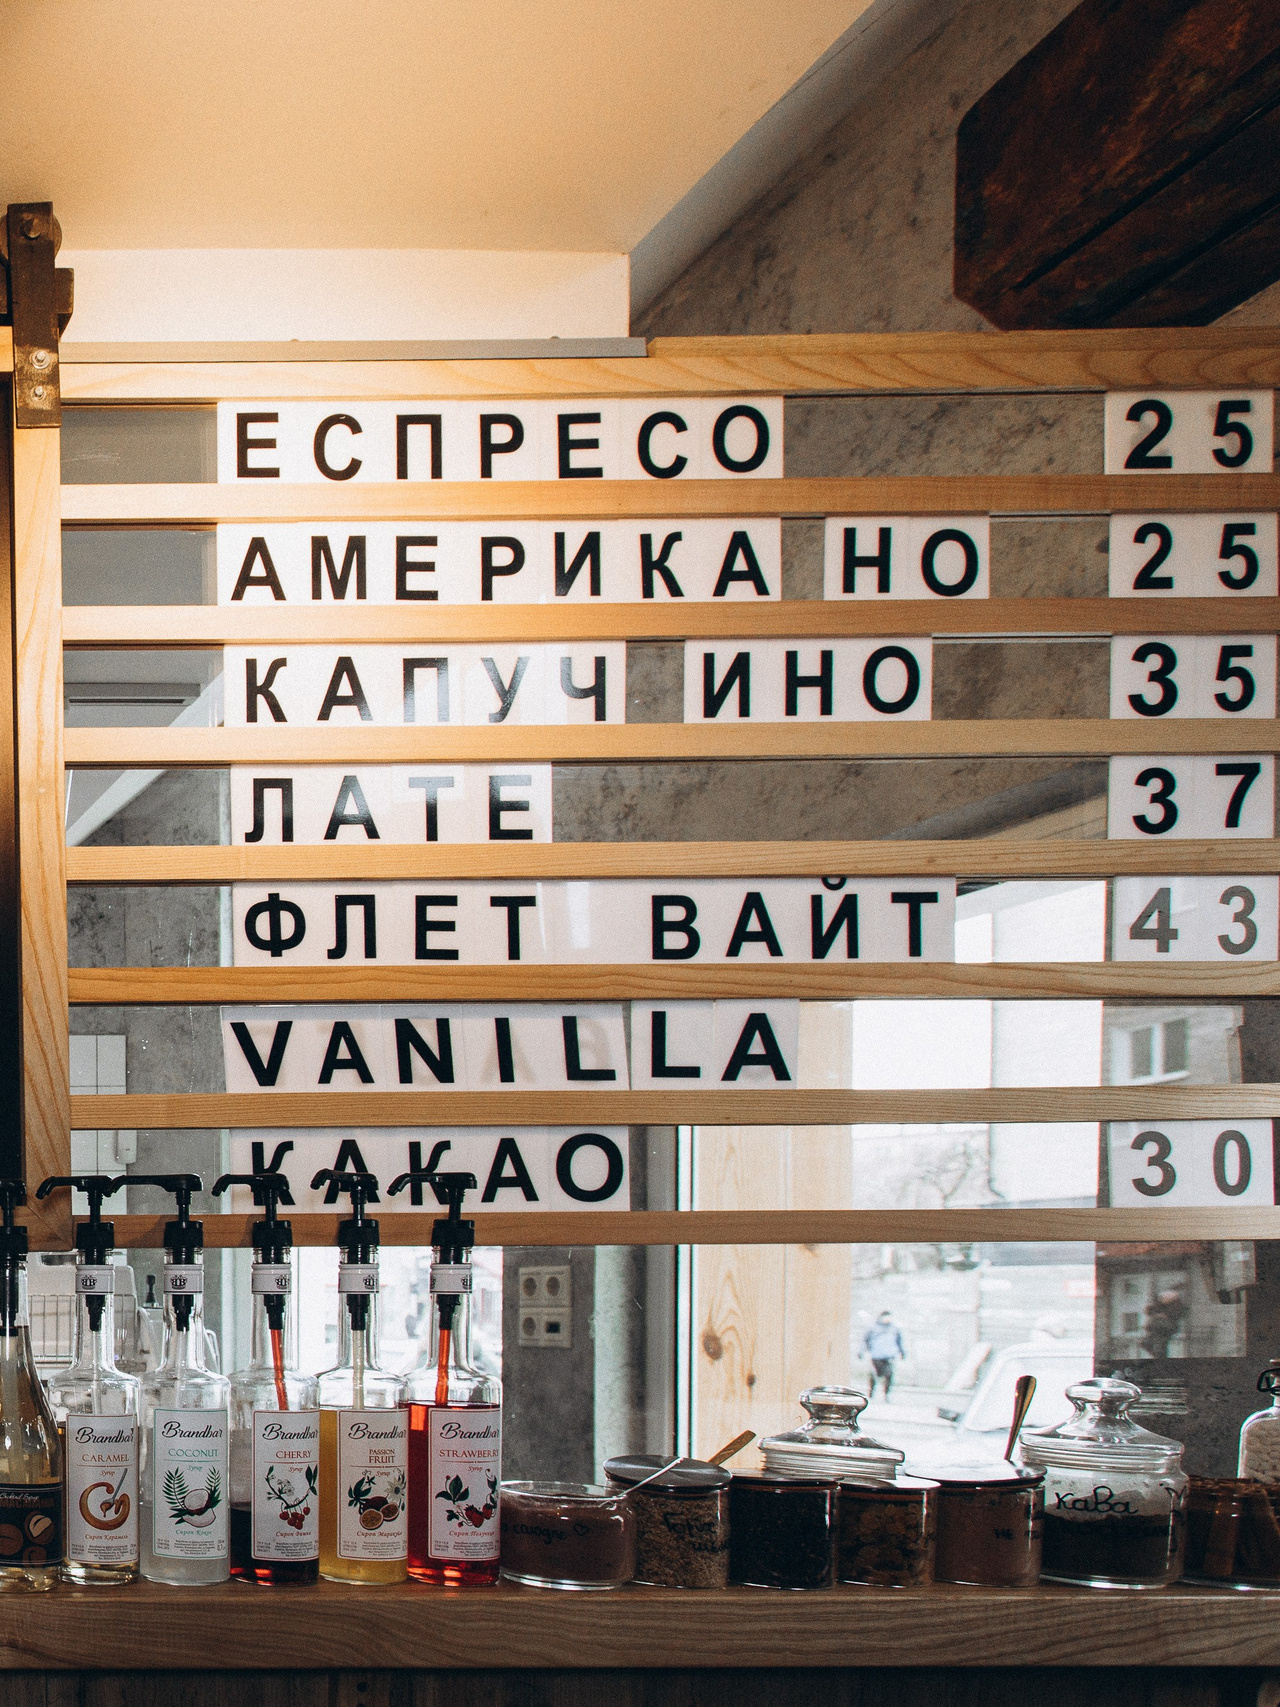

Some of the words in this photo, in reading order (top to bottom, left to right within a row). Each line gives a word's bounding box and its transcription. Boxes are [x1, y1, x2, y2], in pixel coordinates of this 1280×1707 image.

[236, 405, 770, 481] ЕСПРЕСО
[1124, 399, 1253, 469] 25
[1133, 523, 1259, 589] 25
[1128, 642, 1255, 716] 35
[244, 774, 534, 842] ЛАТЕ
[1132, 763, 1261, 834] 37
[245, 893, 536, 960] ФЛЕТ
[652, 876, 938, 960] ВАЙТ
[1129, 886, 1257, 955] 43
[230, 1011, 791, 1086] VANILLA
[252, 1134, 623, 1206] КАКАО
[1130, 1130, 1252, 1196] 30
[75, 1427, 134, 1444] Brandbar
[162, 1421, 222, 1438] Brandbar
[262, 1423, 318, 1440] Brandbar
[348, 1423, 406, 1439] Brandbar
[440, 1422, 499, 1439] Brandbar
[82, 1454, 129, 1462] CARAMEL
[168, 1449, 218, 1457] COCONUT
[276, 1451, 311, 1459] CHERRY
